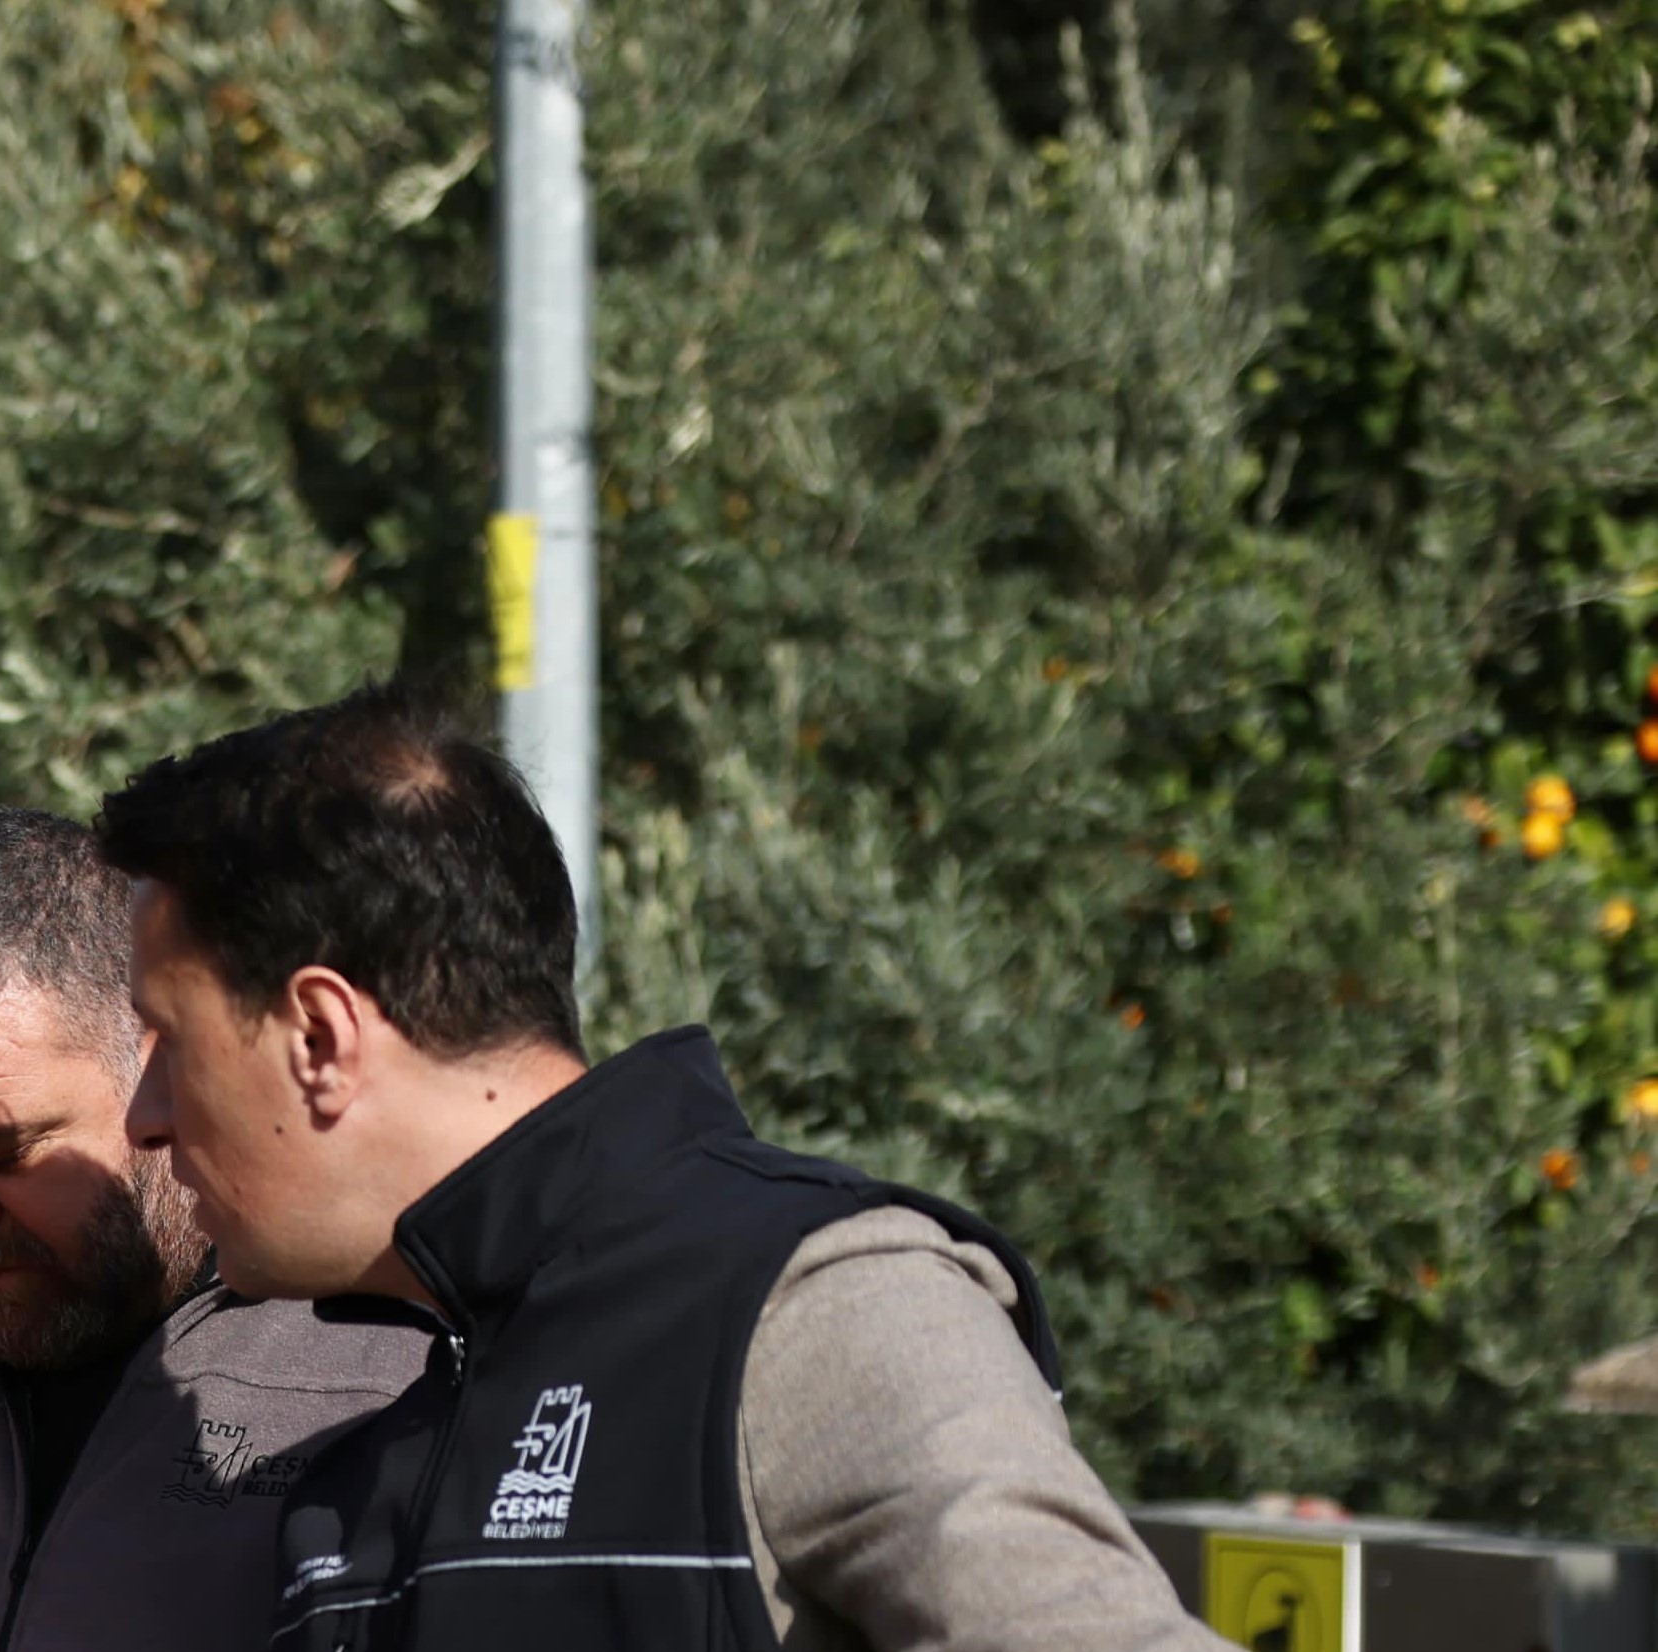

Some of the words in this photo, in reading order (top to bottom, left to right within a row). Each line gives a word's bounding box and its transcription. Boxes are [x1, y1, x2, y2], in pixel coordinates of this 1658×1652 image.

[251, 1455, 315, 1479] ÇEŞ
[489, 1494, 572, 1523] ÇEŞME
[482, 1519, 567, 1539] BELEDİYESİ
